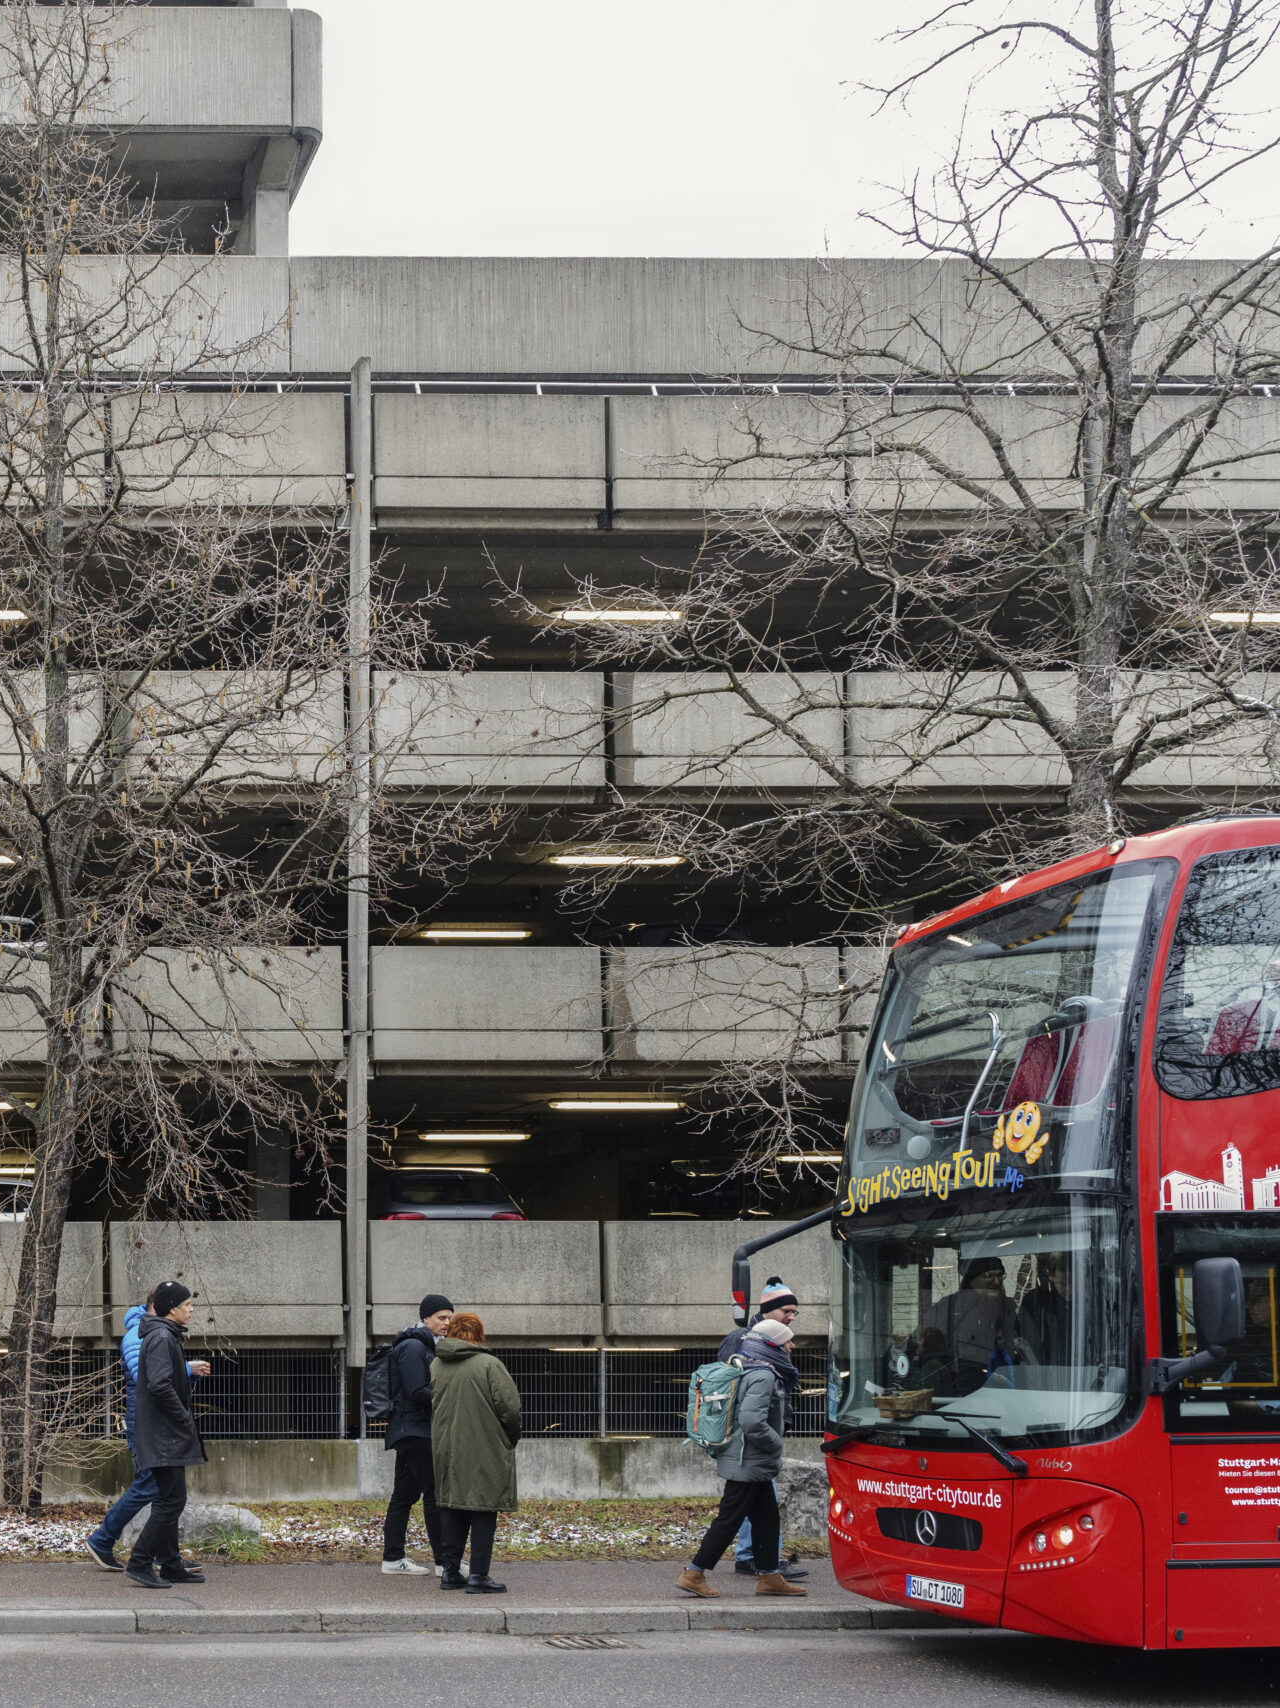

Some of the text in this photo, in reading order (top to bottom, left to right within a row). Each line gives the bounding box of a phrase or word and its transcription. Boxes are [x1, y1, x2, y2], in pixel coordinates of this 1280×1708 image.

[857, 1478, 1002, 1509] www.stuttgart-citytour.de
[911, 1579, 962, 1605] SU CT 1080
